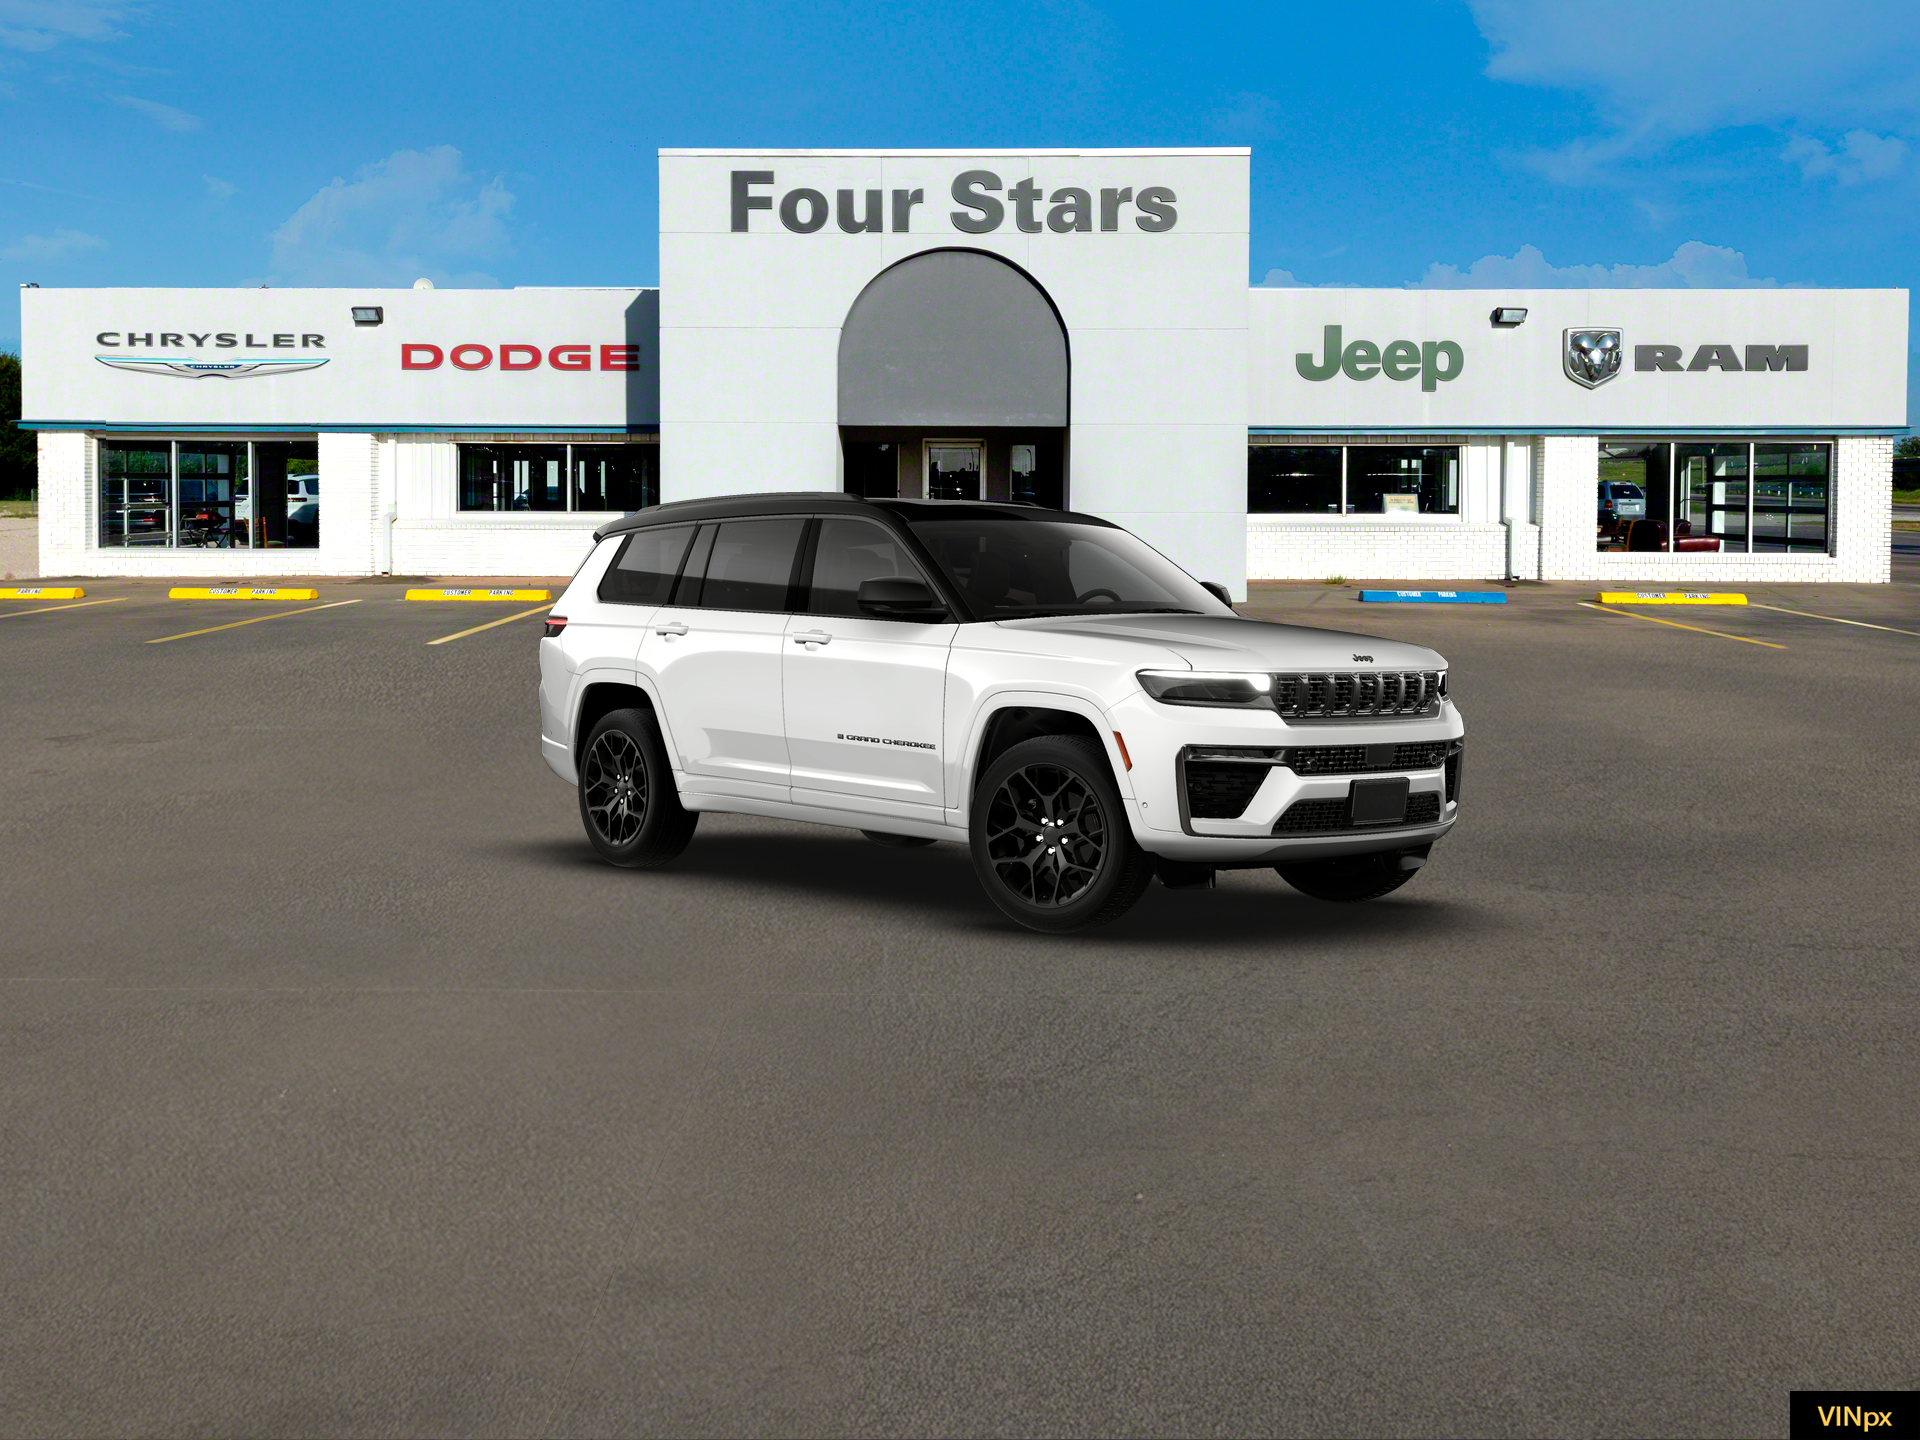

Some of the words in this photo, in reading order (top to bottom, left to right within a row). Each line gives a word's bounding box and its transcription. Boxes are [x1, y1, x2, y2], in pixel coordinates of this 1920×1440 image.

[730, 170, 924, 233] Four
[949, 169, 1178, 233] Stars
[96, 332, 327, 348] CHRYSLER
[401, 343, 640, 371] DODGE
[1295, 324, 1465, 393] Jeep
[1634, 344, 1809, 372] RAM
[1352, 653, 1374, 664] Jeep
[846, 734, 880, 743] GRAND
[882, 738, 936, 750] CHEROKEE
